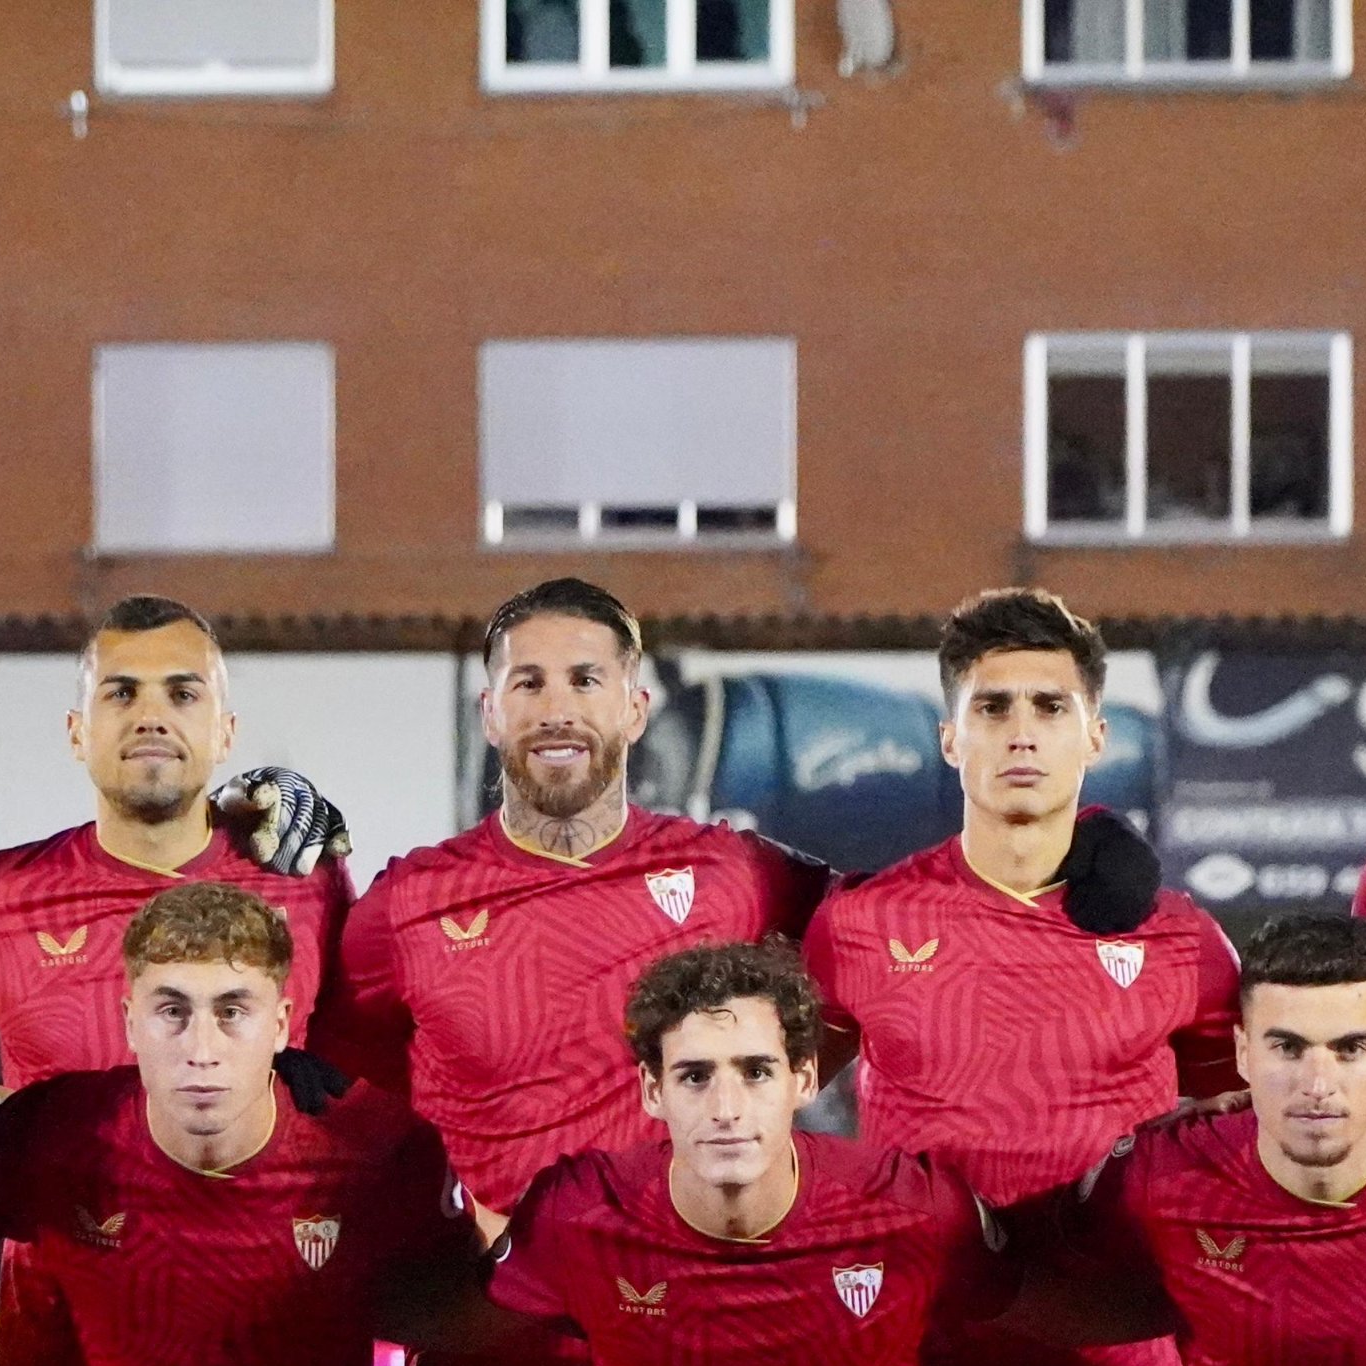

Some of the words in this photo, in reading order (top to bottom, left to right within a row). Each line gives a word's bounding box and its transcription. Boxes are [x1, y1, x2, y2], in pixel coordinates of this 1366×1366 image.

[443, 938, 491, 953] CASTORE
[40, 955, 89, 968] CASTORE
[887, 963, 935, 974] CASTORE
[618, 1303, 668, 1317] CASTORE
